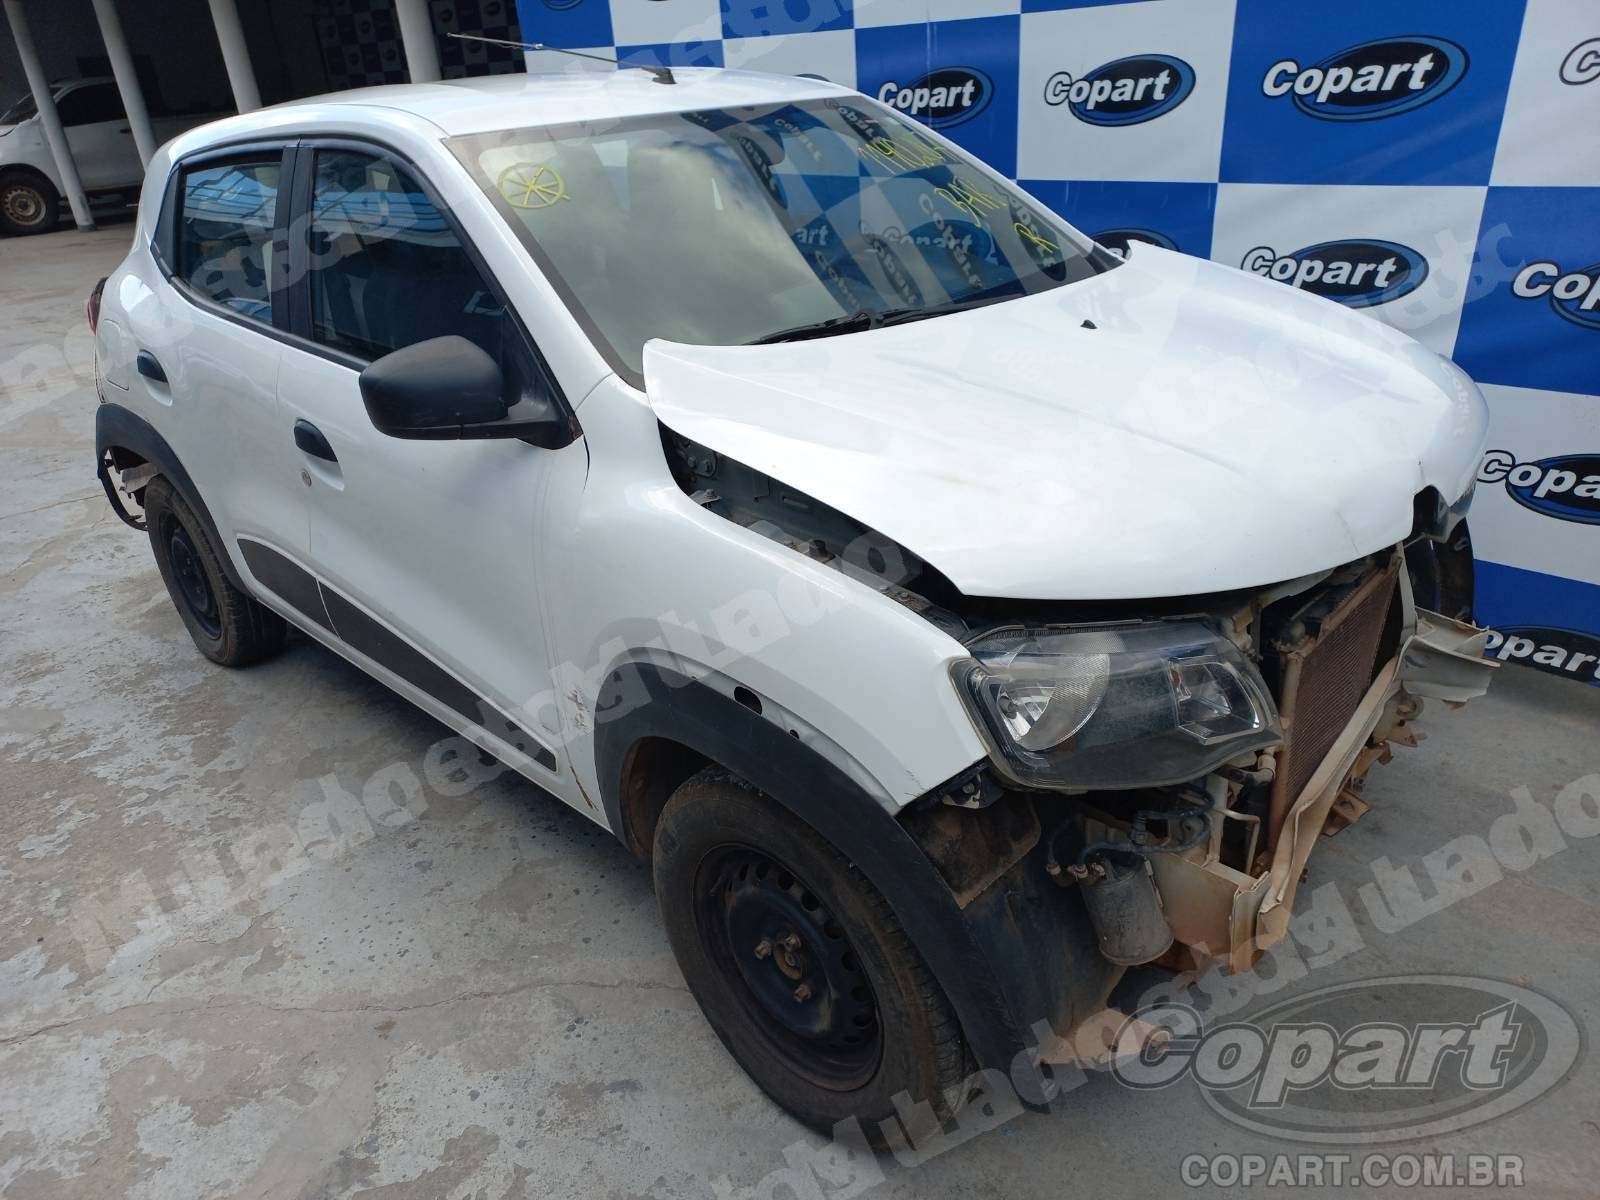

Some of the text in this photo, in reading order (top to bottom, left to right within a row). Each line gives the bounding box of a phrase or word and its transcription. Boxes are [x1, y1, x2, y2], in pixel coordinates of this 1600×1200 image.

[878, 79, 976, 115] Copart
[1044, 68, 1171, 109] Copart
[1262, 51, 1434, 103] Copart
[1241, 245, 1398, 291] Copart
